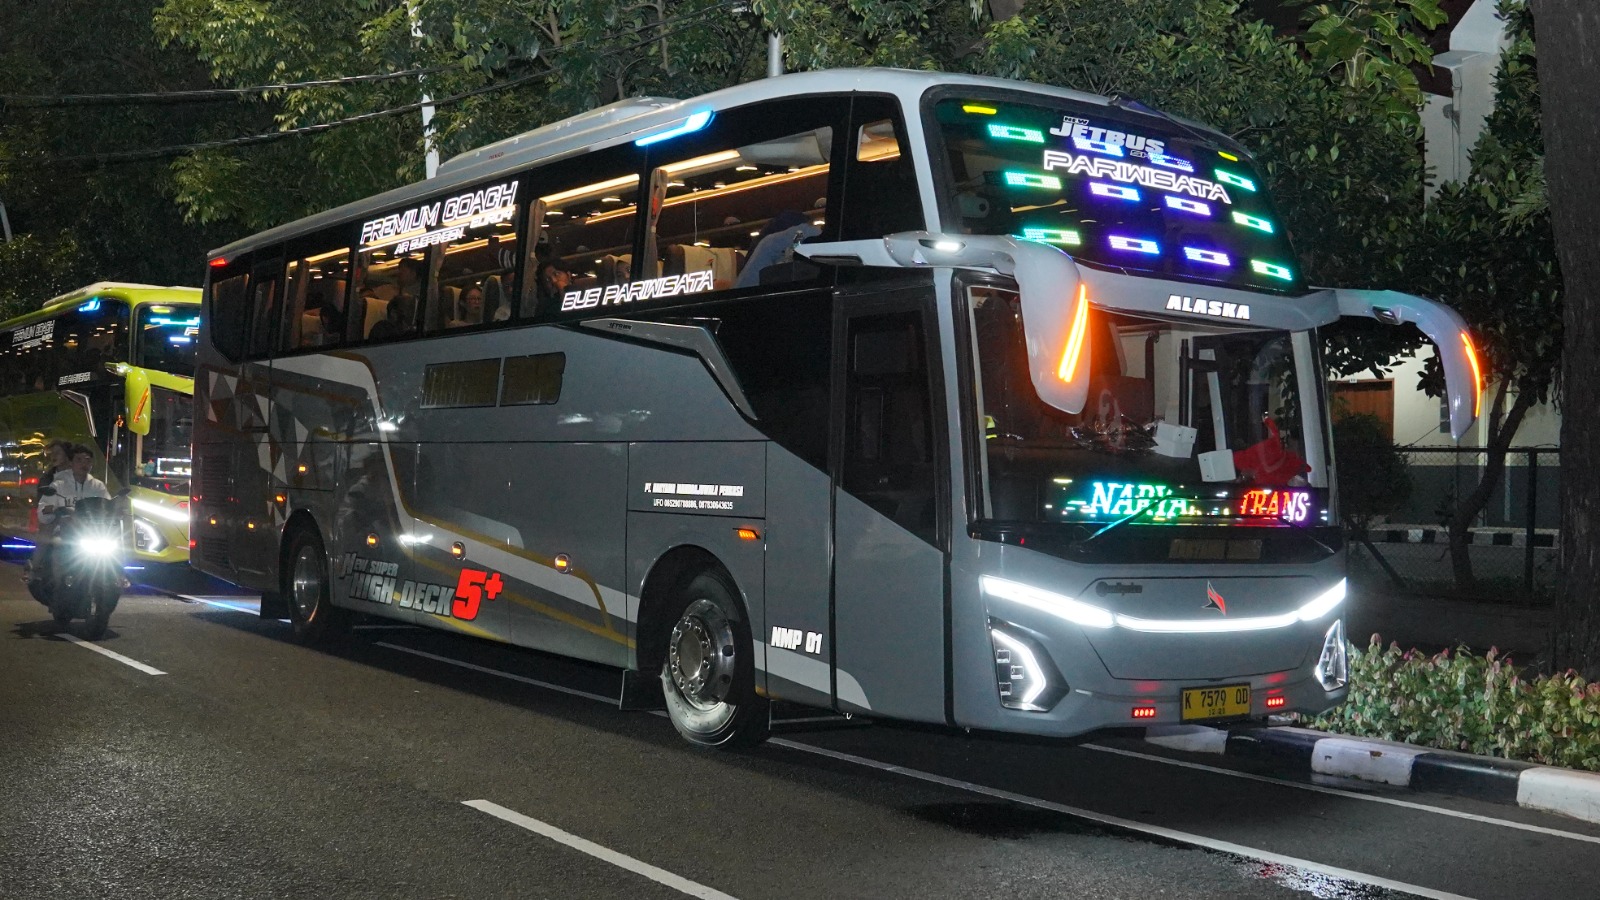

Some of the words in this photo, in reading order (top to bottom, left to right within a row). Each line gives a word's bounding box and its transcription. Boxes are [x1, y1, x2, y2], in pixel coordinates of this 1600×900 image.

[1049, 122, 1166, 155] JETBUS
[1043, 150, 1232, 205] PARIWISATA
[360, 202, 441, 245] PREMIUM
[442, 181, 519, 223] COACH
[560, 288, 602, 312] BUS
[602, 269, 715, 306] PARIWISATA
[1166, 294, 1250, 320] ALASKA
[1241, 490, 1310, 522] TRANS
[369, 560, 399, 577] SUPER
[350, 573, 397, 605] HIGH
[399, 579, 455, 617] DECK
[771, 626, 803, 650] NMP
[805, 631, 823, 655] 01
[1184, 692, 1193, 710] K
[1200, 688, 1227, 708] 7579
